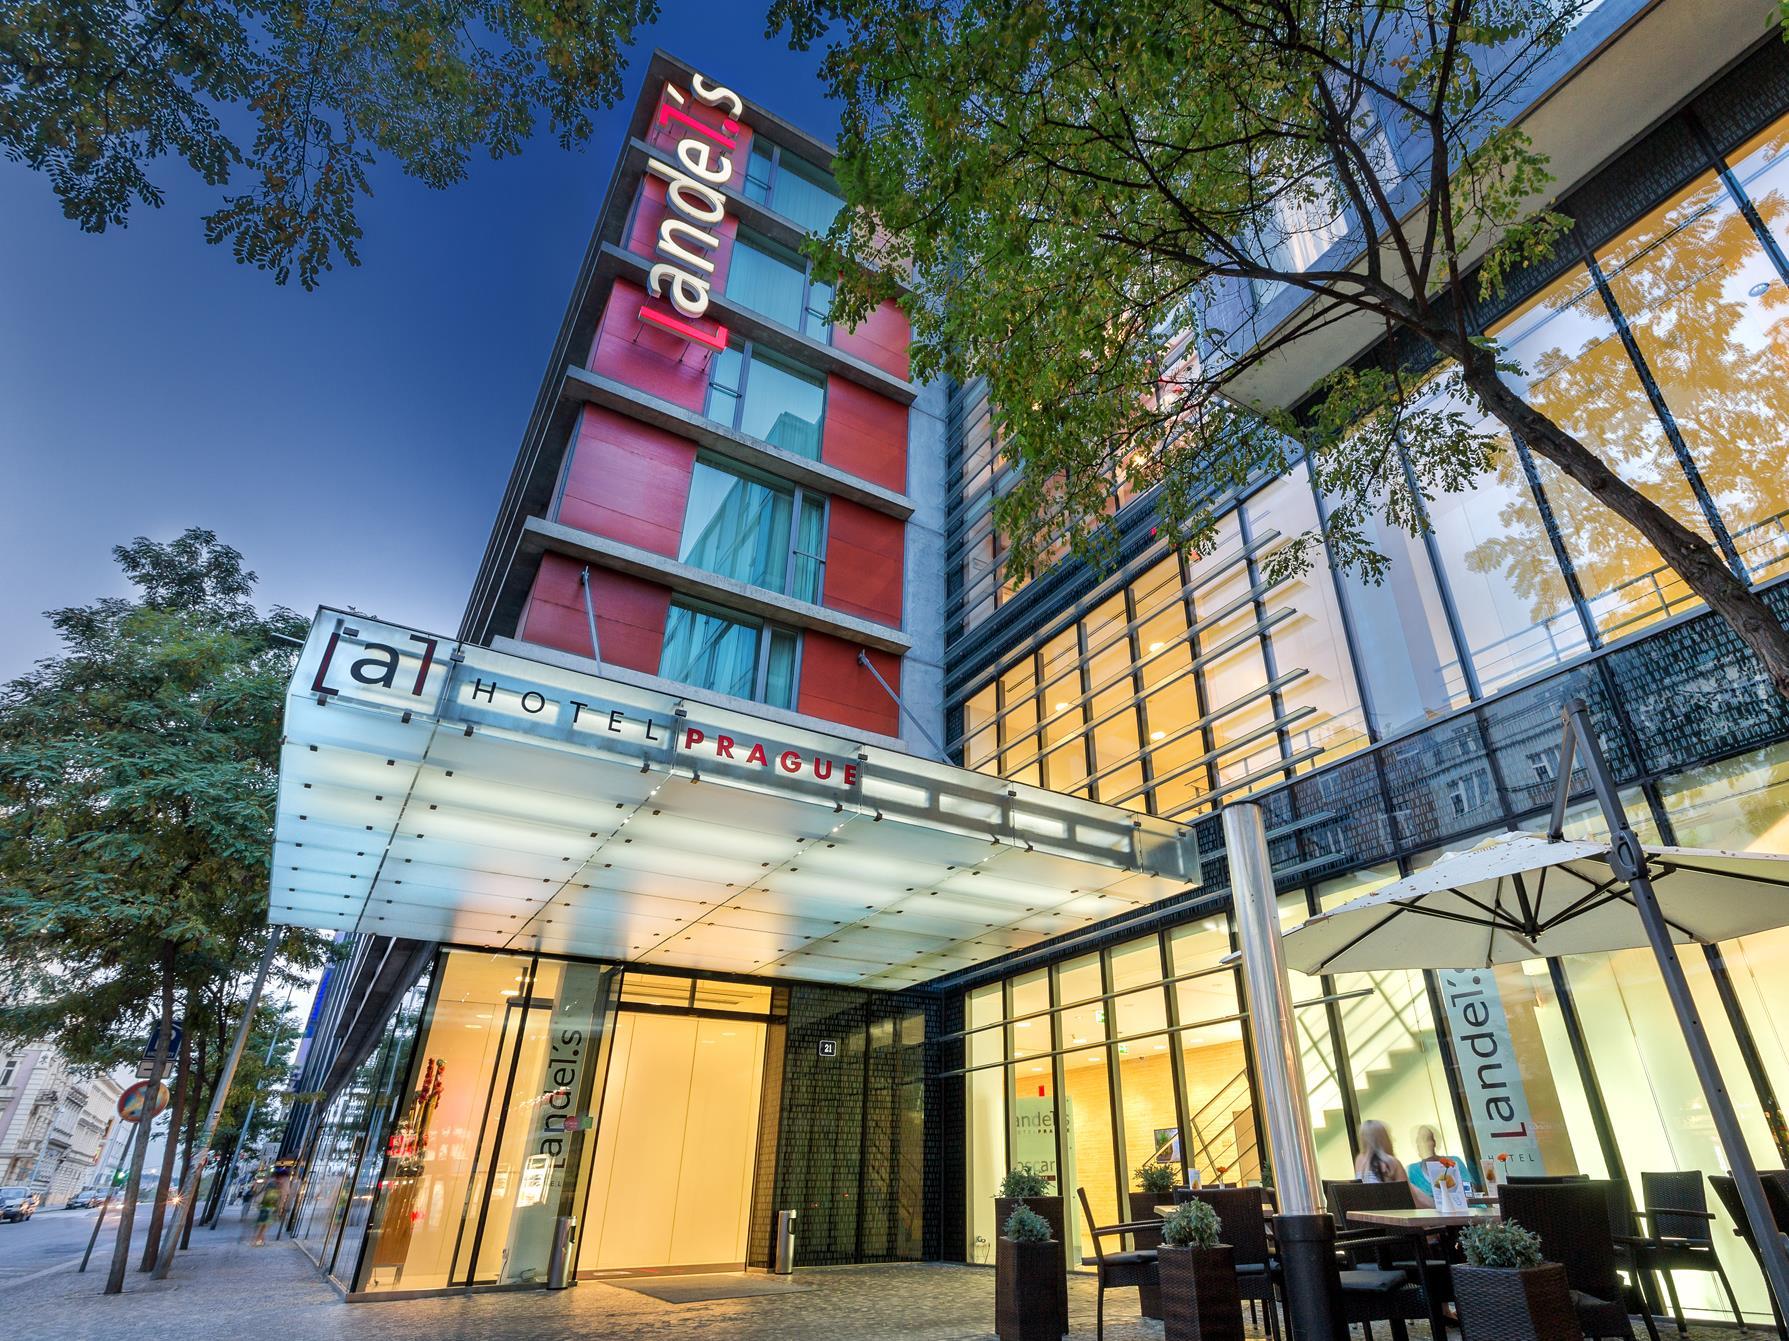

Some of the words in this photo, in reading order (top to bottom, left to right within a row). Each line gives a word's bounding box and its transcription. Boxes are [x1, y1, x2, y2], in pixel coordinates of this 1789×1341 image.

[472, 678, 658, 741] HOTEL
[684, 727, 857, 785] PRAGUE
[824, 1044, 832, 1053] 21
[1488, 1153, 1535, 1162] HTEL
